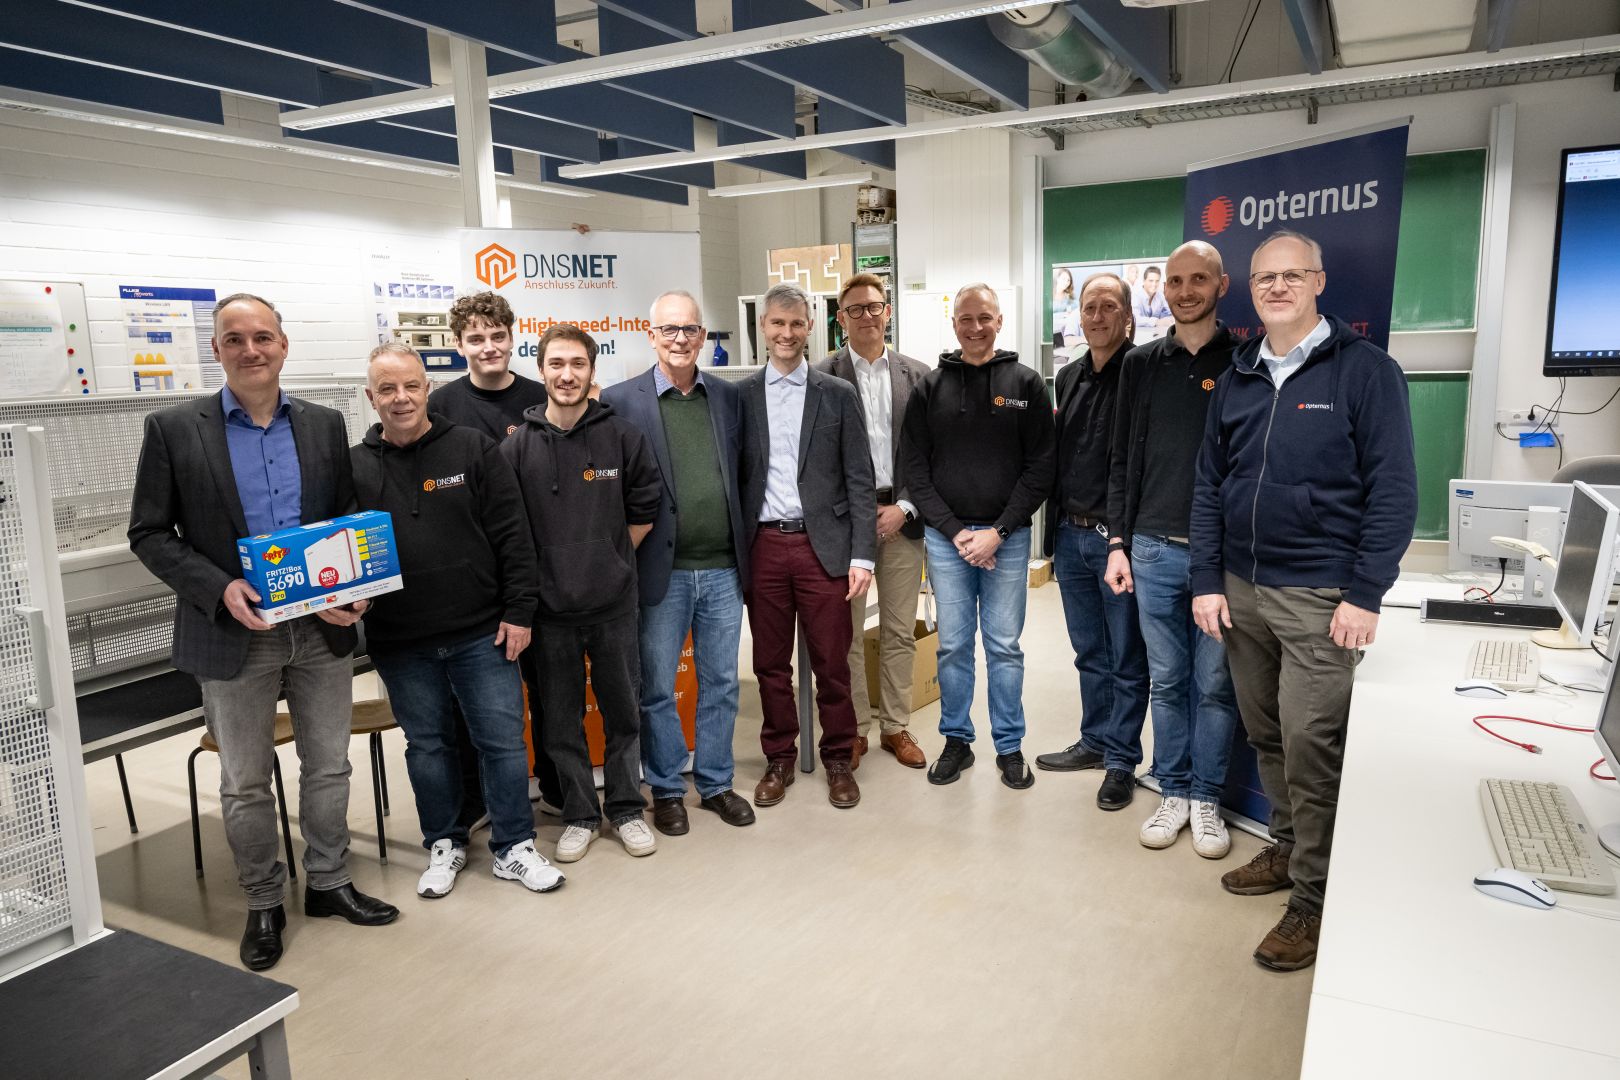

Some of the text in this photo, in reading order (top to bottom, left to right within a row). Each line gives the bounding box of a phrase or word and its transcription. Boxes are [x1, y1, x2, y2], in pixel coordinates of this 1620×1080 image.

[1239, 180, 1378, 230] Opternus
[523, 254, 617, 278] DNSNET
[524, 280, 618, 290] Anschluss Zukunft.
[1006, 399, 1028, 407] DNSNET
[436, 473, 464, 486] DNSNET
[596, 469, 618, 477] DNSNET
[266, 565, 302, 578] FRITZ!Box
[267, 571, 305, 592] 5690
